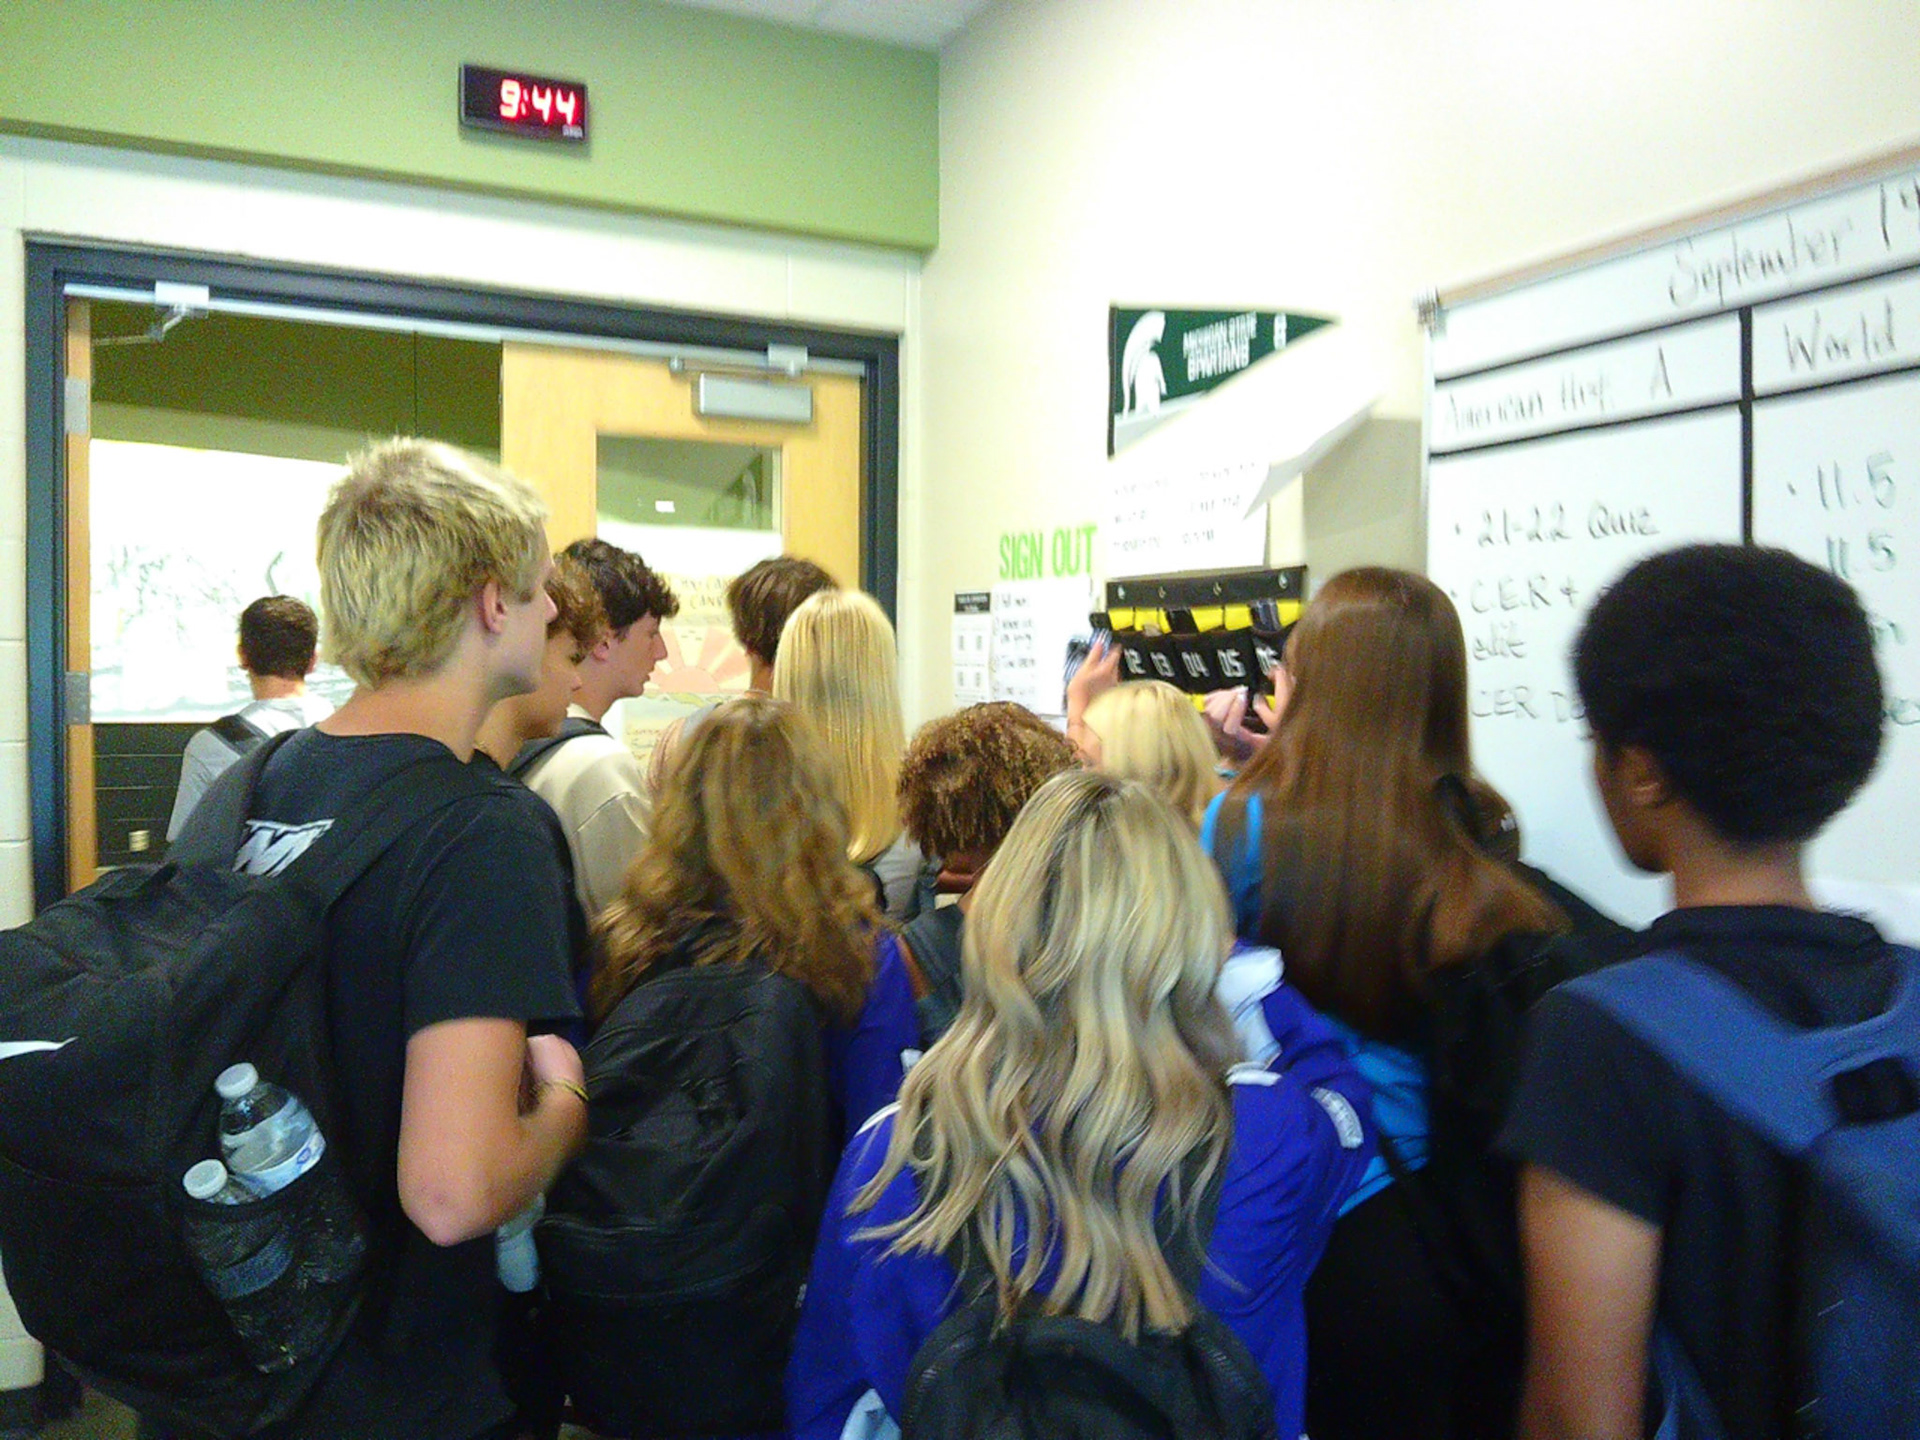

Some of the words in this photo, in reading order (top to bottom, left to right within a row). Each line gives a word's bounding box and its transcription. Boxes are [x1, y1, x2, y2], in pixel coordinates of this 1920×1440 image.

[500, 79, 576, 125] 9:44
[1668, 212, 1851, 306] September
[1784, 297, 1896, 371] World
[1000, 530, 1043, 580] SIGN
[1052, 524, 1098, 577] OUT
[1217, 649, 1246, 678] 05
